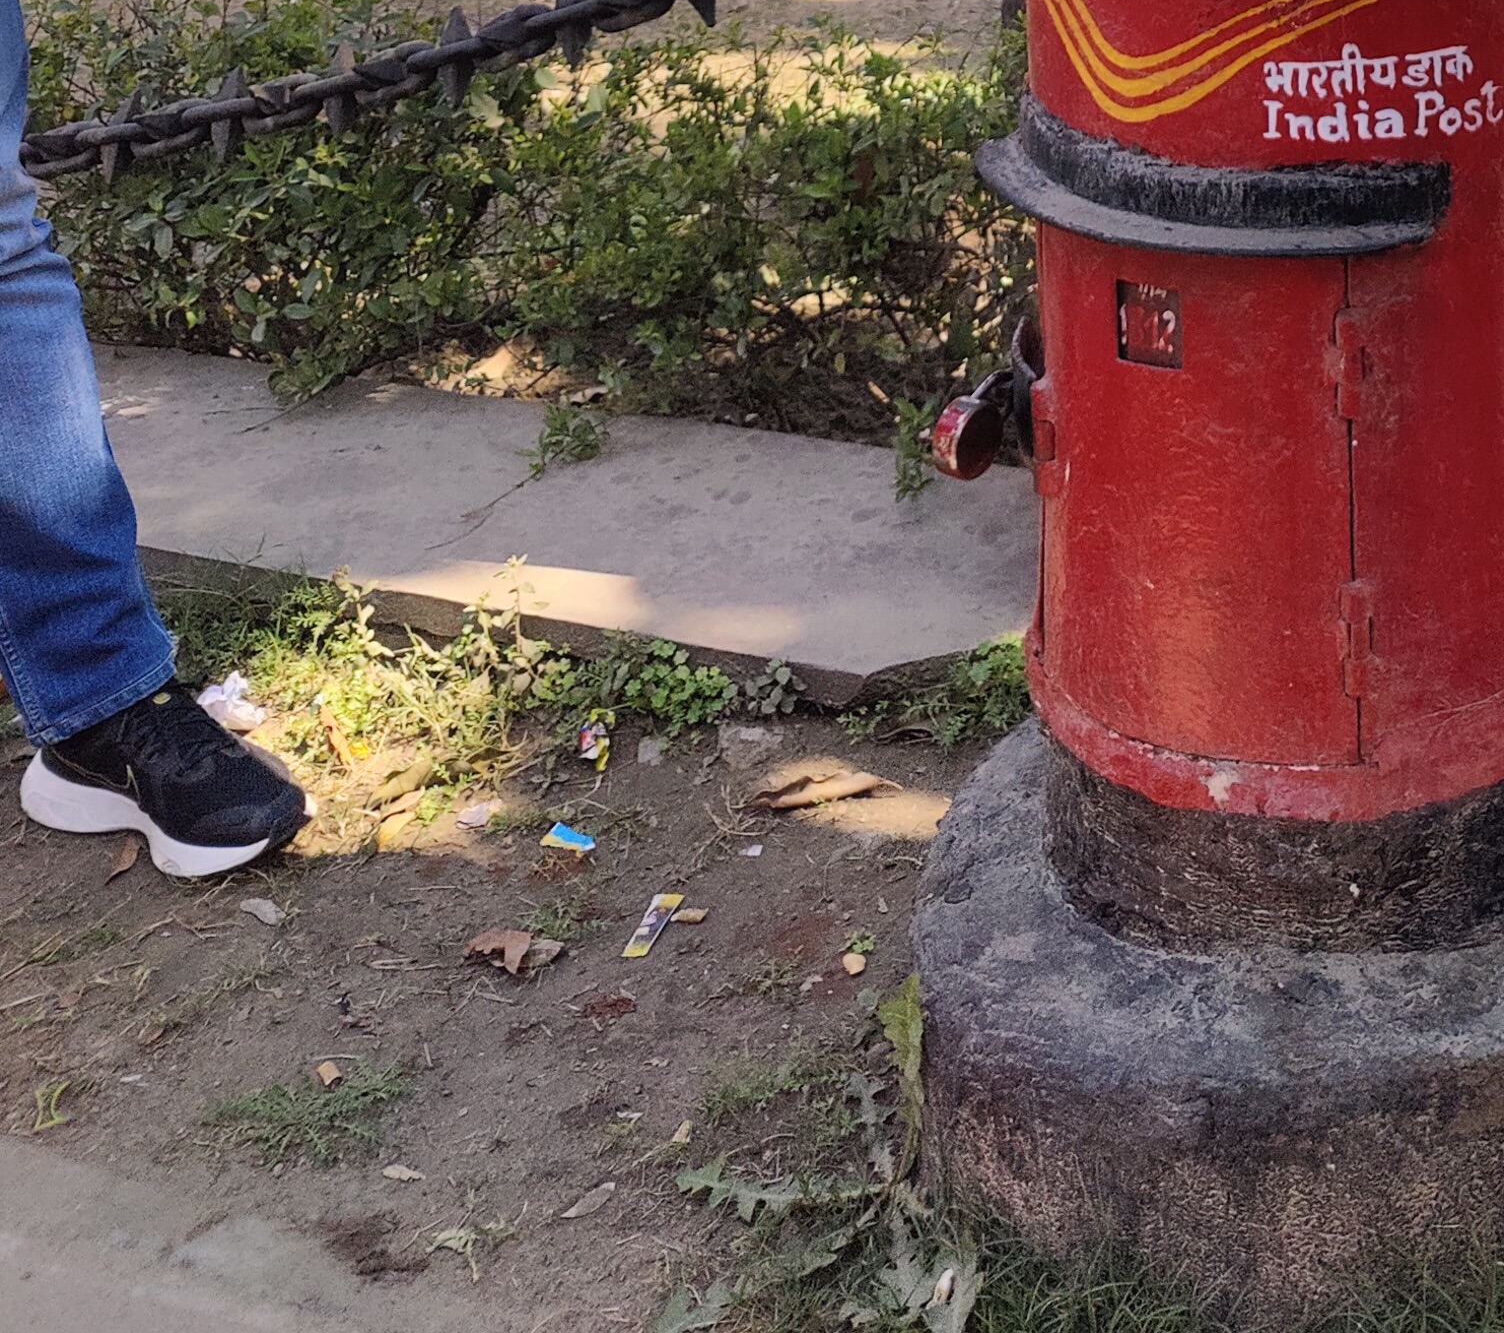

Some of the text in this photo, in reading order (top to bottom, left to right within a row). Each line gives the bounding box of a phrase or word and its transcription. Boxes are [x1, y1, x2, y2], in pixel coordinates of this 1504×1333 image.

[1263, 42, 1474, 99] भारतीय डाक
[1262, 80, 1504, 143] India Post
